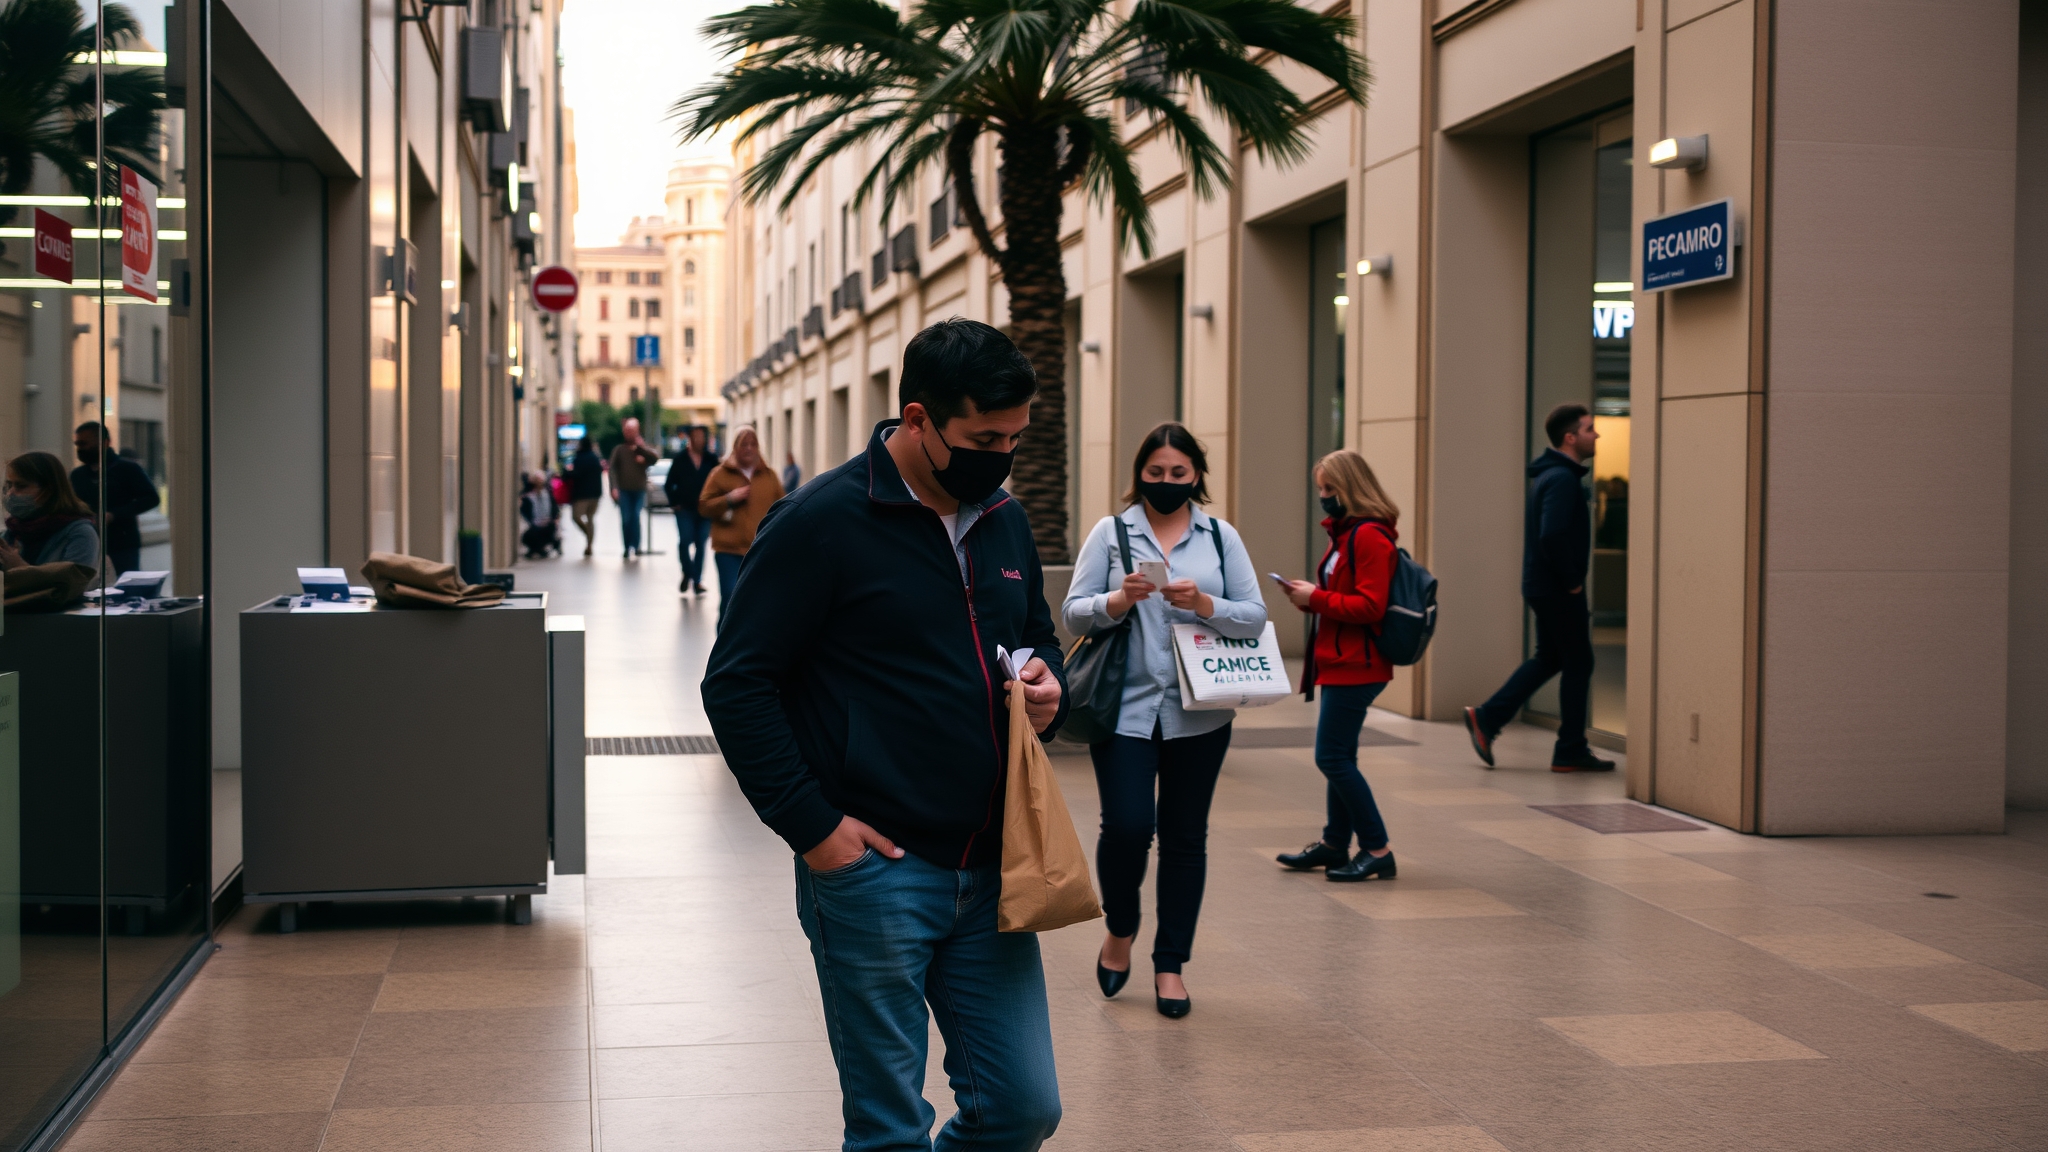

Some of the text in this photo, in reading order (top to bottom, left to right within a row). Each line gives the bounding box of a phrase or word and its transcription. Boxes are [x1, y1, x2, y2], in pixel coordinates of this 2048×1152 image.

[1648, 223, 1722, 262] PECAMRO
[1593, 307, 1635, 338] VP
[1203, 657, 1270, 673] CAMICE
